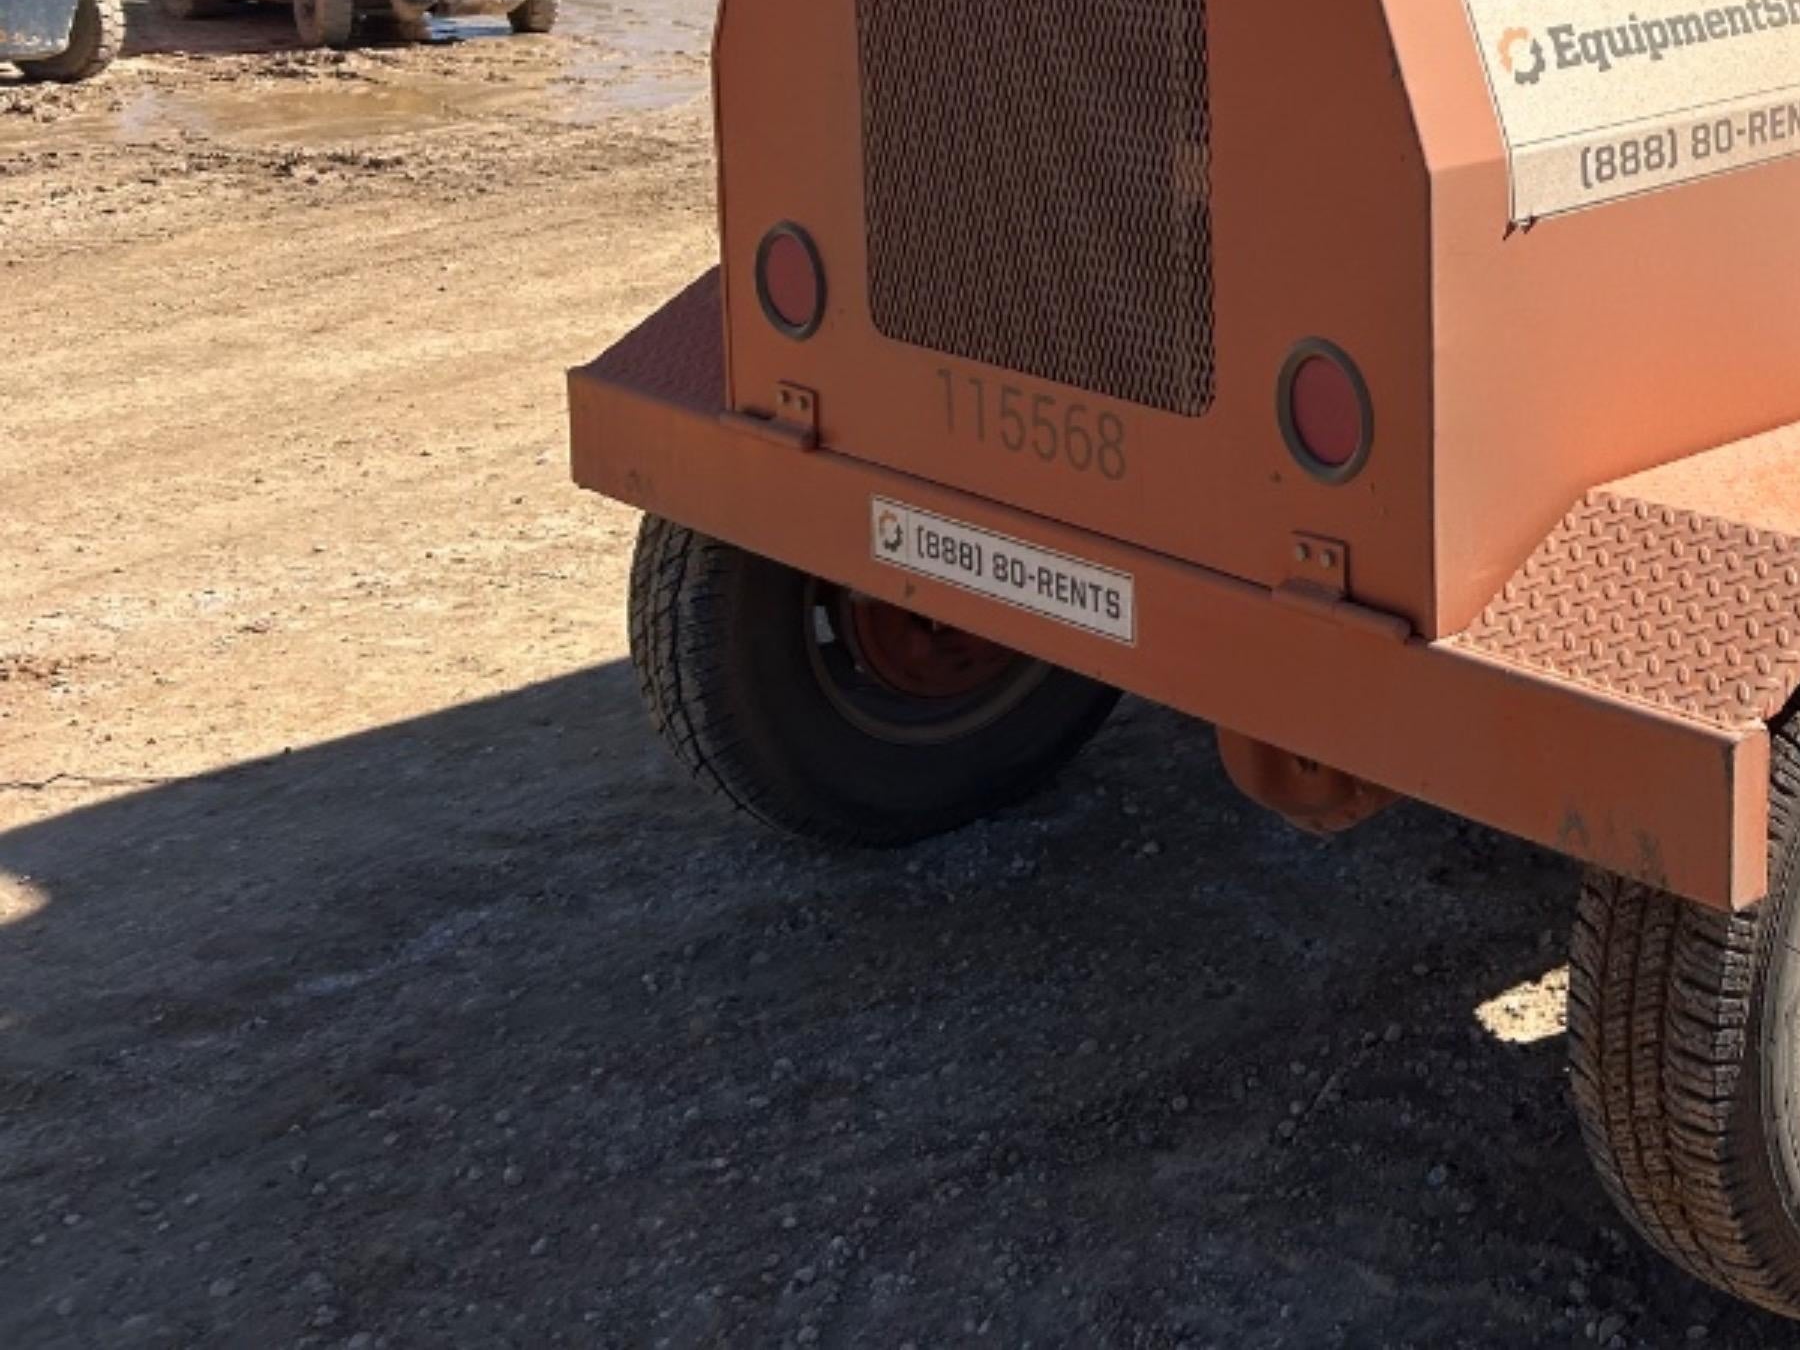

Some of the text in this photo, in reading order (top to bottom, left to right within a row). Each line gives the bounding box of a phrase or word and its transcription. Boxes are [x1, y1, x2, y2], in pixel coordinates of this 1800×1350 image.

[1579, 128, 1678, 189] (888)
[937, 368, 1127, 481] 115568
[916, 528, 1121, 620] (888) 80-RENTS
